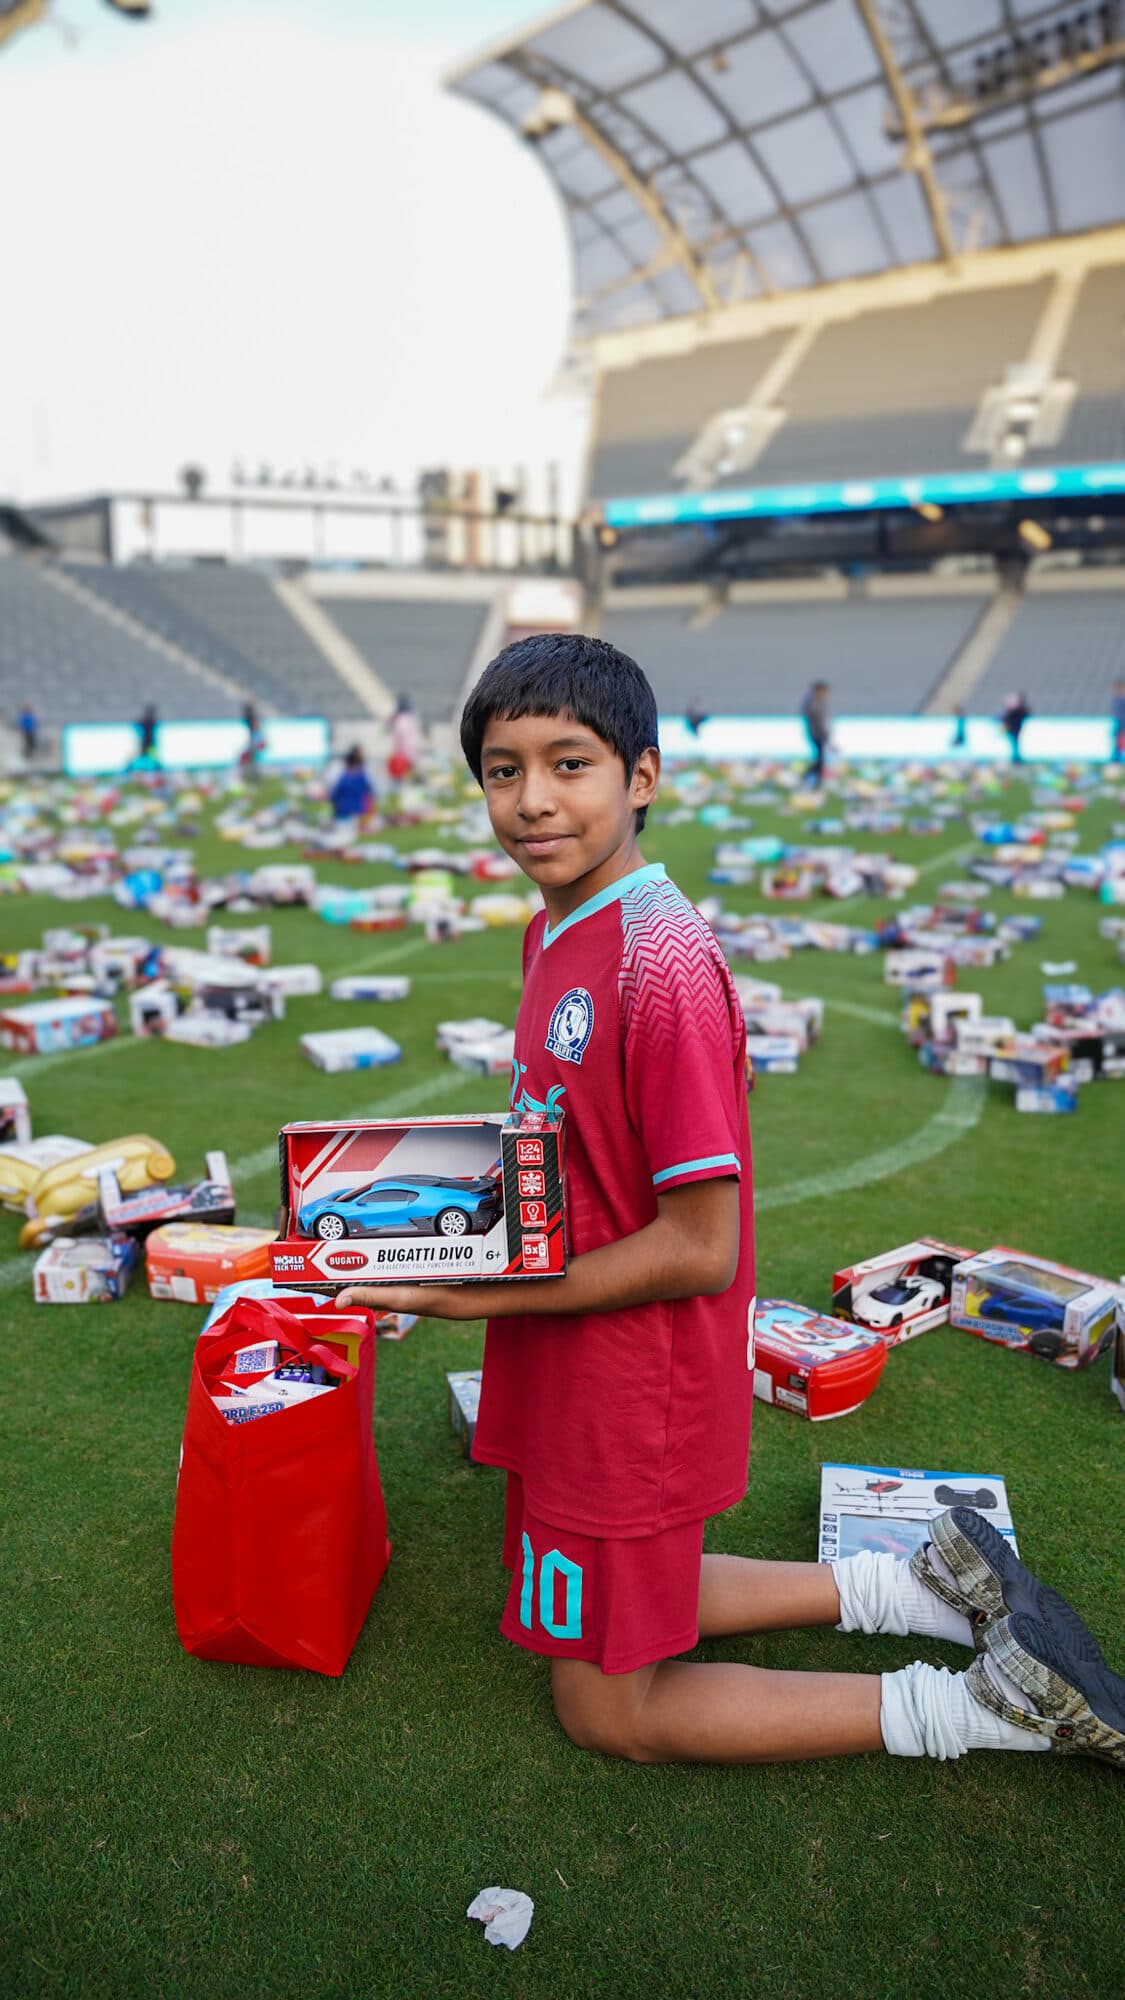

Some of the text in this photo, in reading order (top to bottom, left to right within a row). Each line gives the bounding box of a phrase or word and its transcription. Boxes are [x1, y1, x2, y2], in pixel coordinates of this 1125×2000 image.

[520, 1143, 540, 1154] 1:24
[377, 1246, 473, 1263] BUGATTI DIVO
[485, 1250, 501, 1260] 6+
[525, 1244, 538, 1255] 5x
[273, 1255, 304, 1265] WORLD
[329, 1256, 364, 1265] BUGATTI
[519, 1530, 583, 1640] 10
